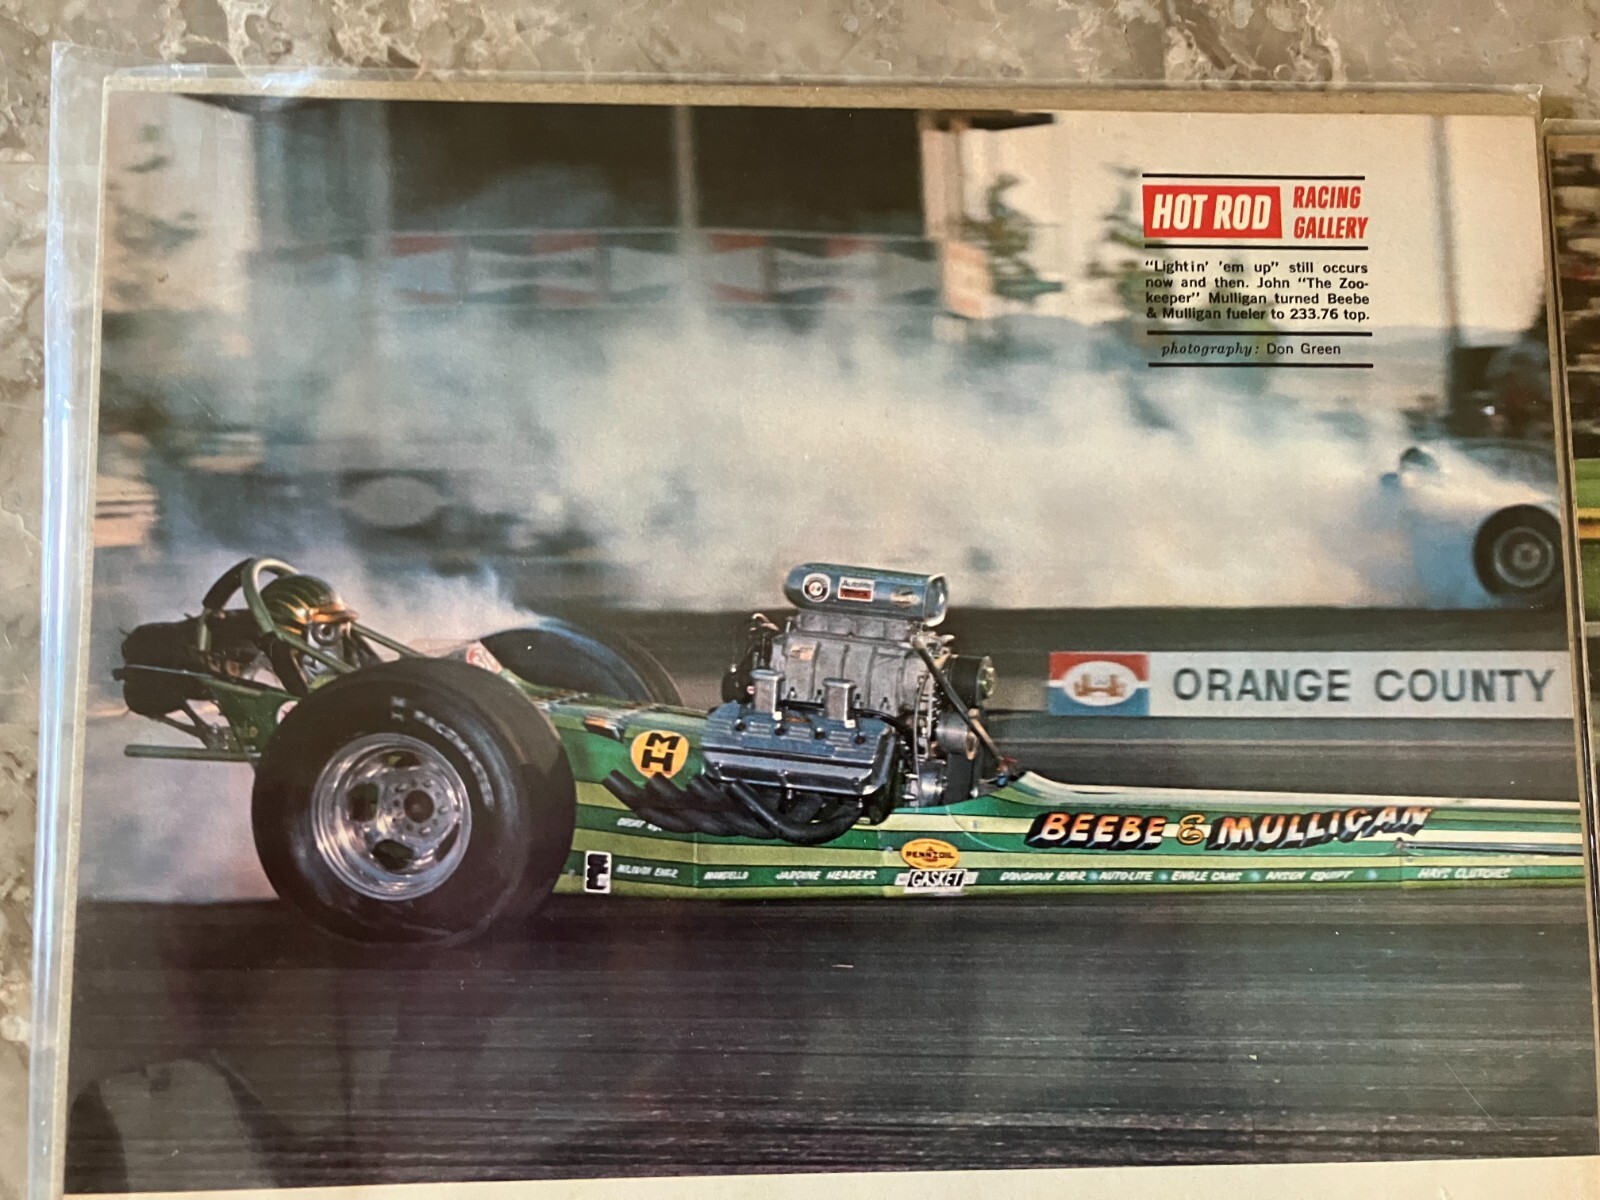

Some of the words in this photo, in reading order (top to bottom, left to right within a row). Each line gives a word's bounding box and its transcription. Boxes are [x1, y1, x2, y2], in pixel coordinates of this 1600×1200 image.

[1292, 186, 1362, 209] RACING
[1151, 193, 1208, 230] HOT
[1213, 194, 1272, 230] ROD
[1293, 216, 1369, 240] GALLERY
[1289, 261, 1314, 273] still
[1322, 263, 1368, 274] occurs
[1145, 278, 1173, 288] now
[1180, 276, 1206, 288] and
[1214, 276, 1249, 289] then.
[1256, 277, 1290, 289] John
[1339, 278, 1369, 289] Zoo-
[1208, 292, 1267, 307] Mulligan
[1274, 292, 1319, 305] turned
[1327, 293, 1370, 305] Beebe
[1146, 307, 1157, 319] &
[1162, 307, 1221, 322] Mulligan
[1226, 307, 1266, 320] fueler
[1271, 308, 1285, 320] to
[1290, 308, 1338, 320] 233.76
[1343, 308, 1370, 322] top.
[1161, 342, 1259, 357] photography:
[1267, 343, 1294, 355] Don
[1300, 343, 1341, 355] Green
[1172, 668, 1351, 702] ORANGE
[1374, 669, 1554, 703] COUNTY
[1028, 812, 1168, 849] BEEBE
[1176, 813, 1206, 846] &
[1206, 806, 1434, 851] MULLIGAN
[826, 870, 878, 880] HEADERS
[911, 871, 963, 887] GASKET
